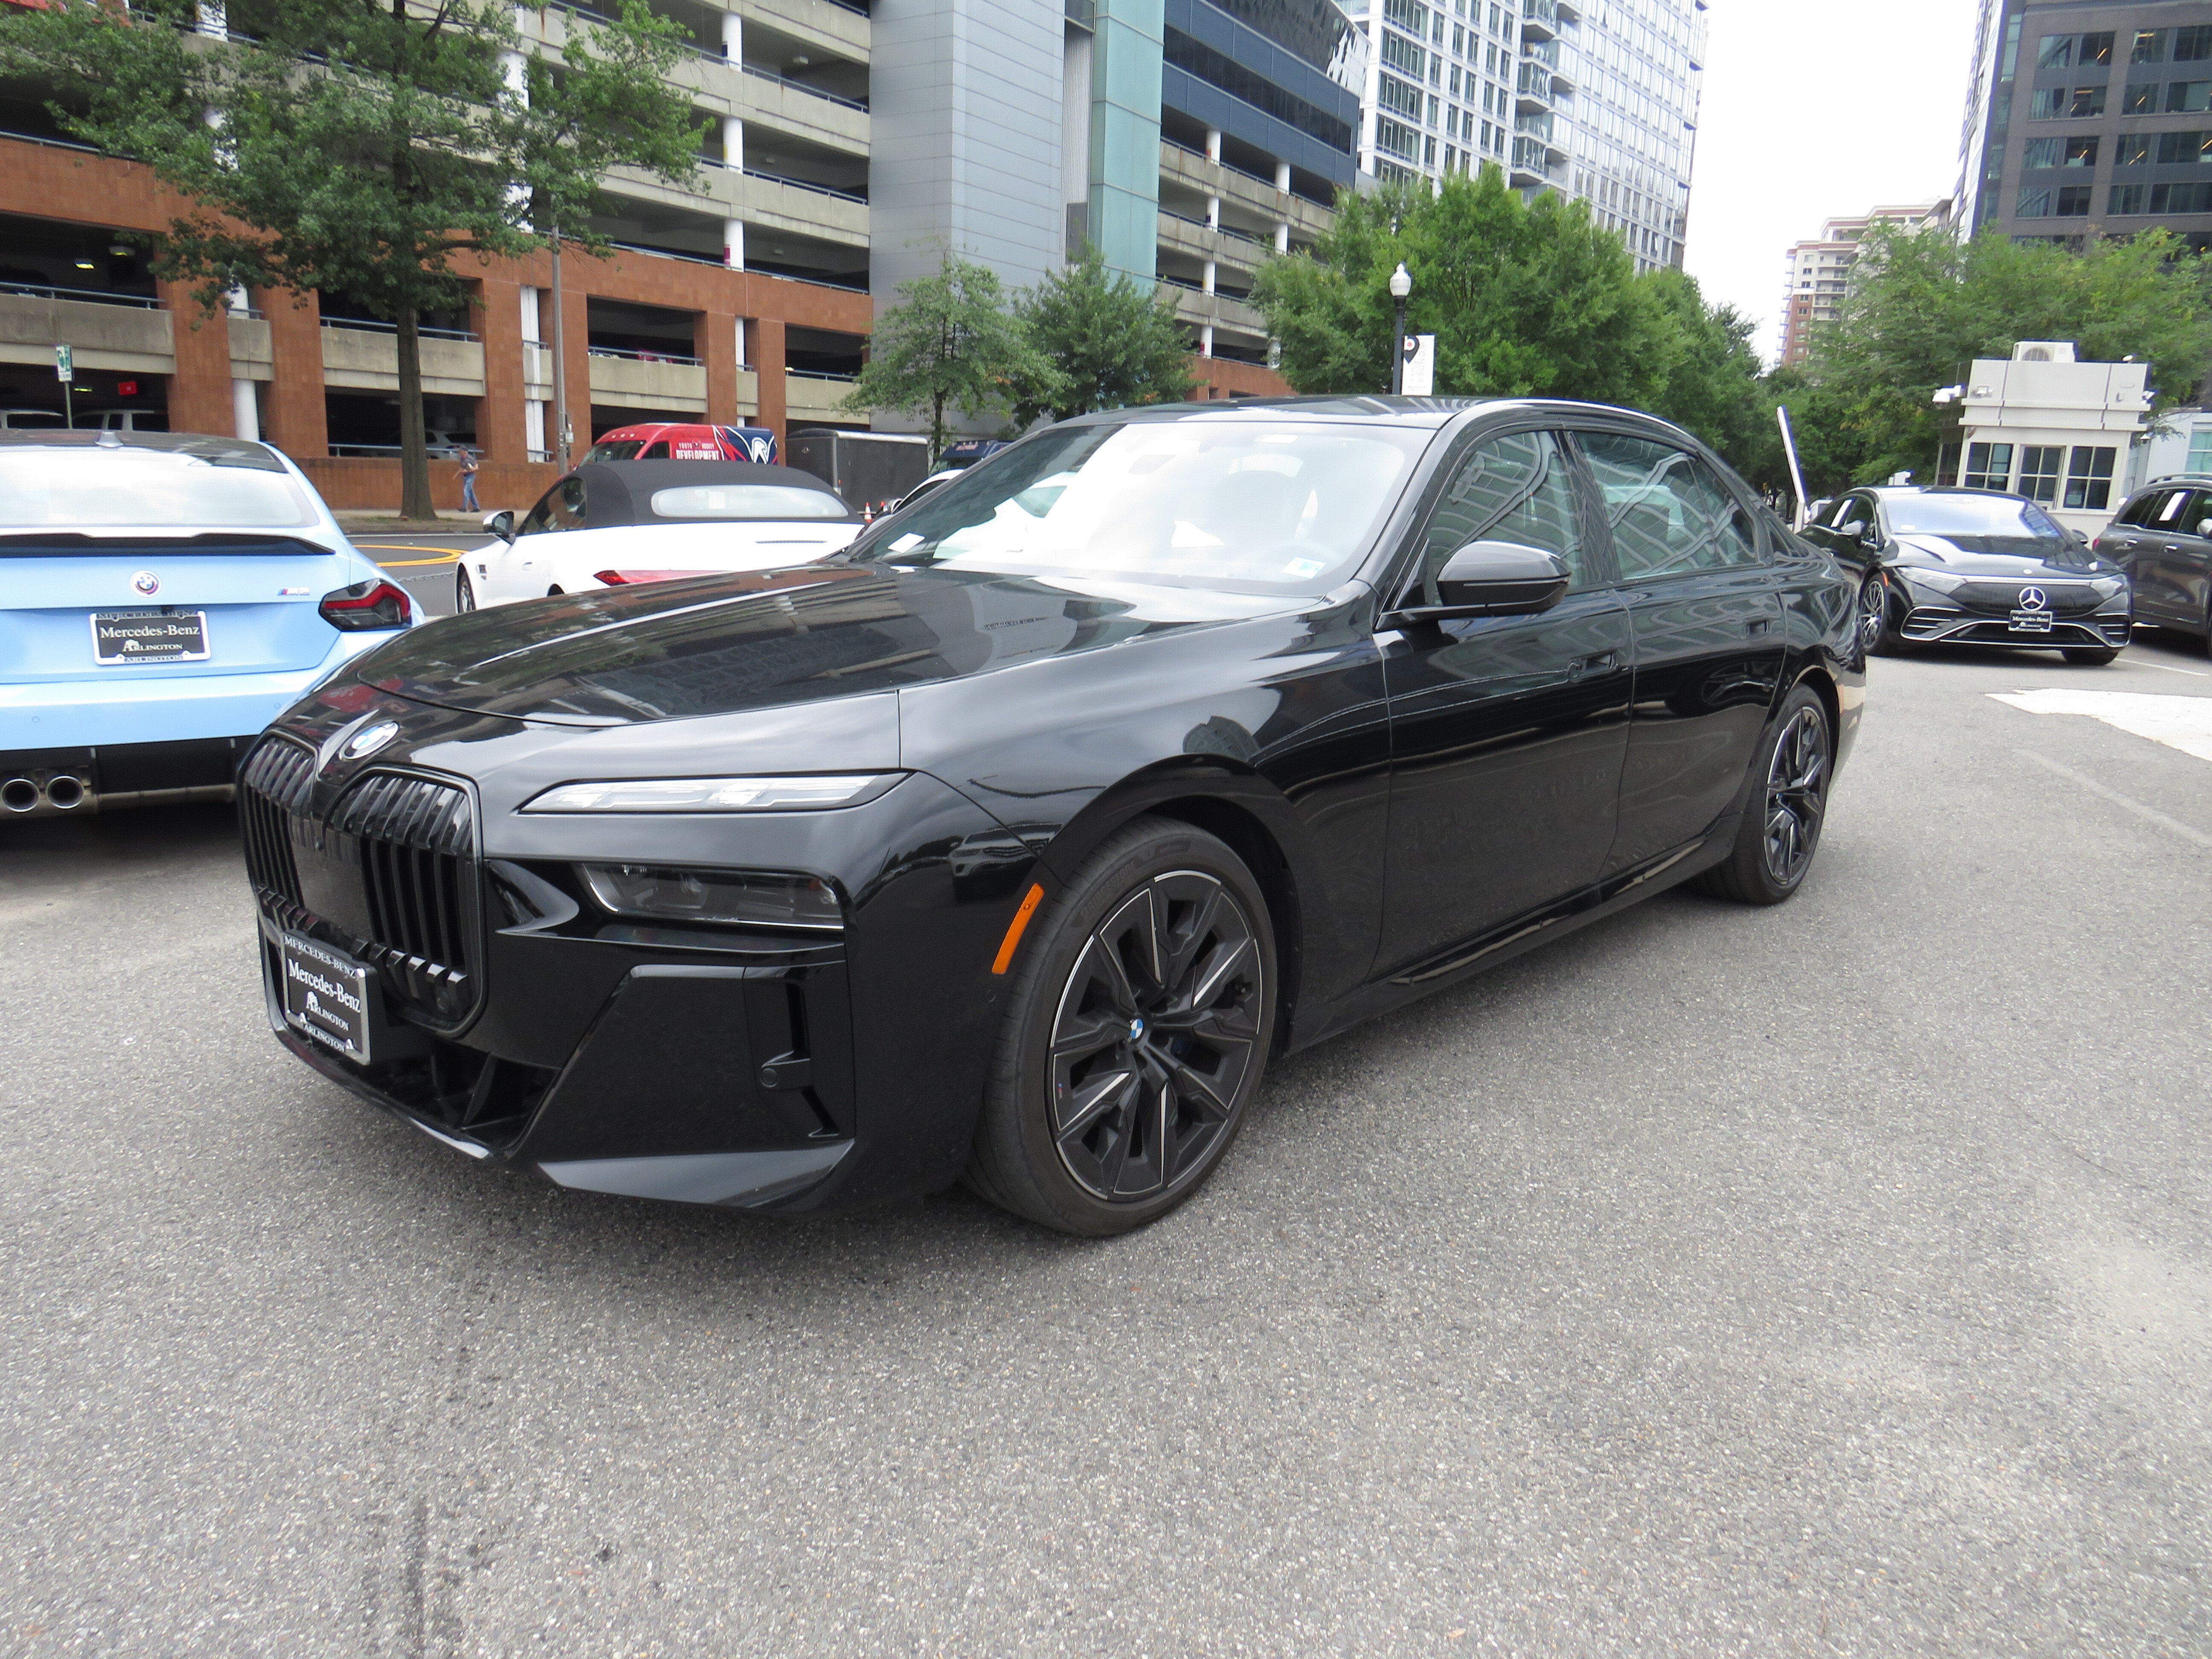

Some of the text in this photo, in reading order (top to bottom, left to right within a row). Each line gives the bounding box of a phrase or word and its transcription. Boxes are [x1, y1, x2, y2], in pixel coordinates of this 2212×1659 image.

[676, 449, 719, 460] DEVELOPMENT
[97, 611, 197, 620] MERCEDESBENZ
[99, 624, 200, 639] Mercedes-Benz
[122, 639, 183, 652] ARLINGTON
[284, 935, 356, 979] MERCEDES-BENZ
[288, 958, 361, 1013] Mercedes-Benz
[306, 990, 349, 1032] ARLINGTON
[303, 1024, 346, 1052] ARLINGTON
